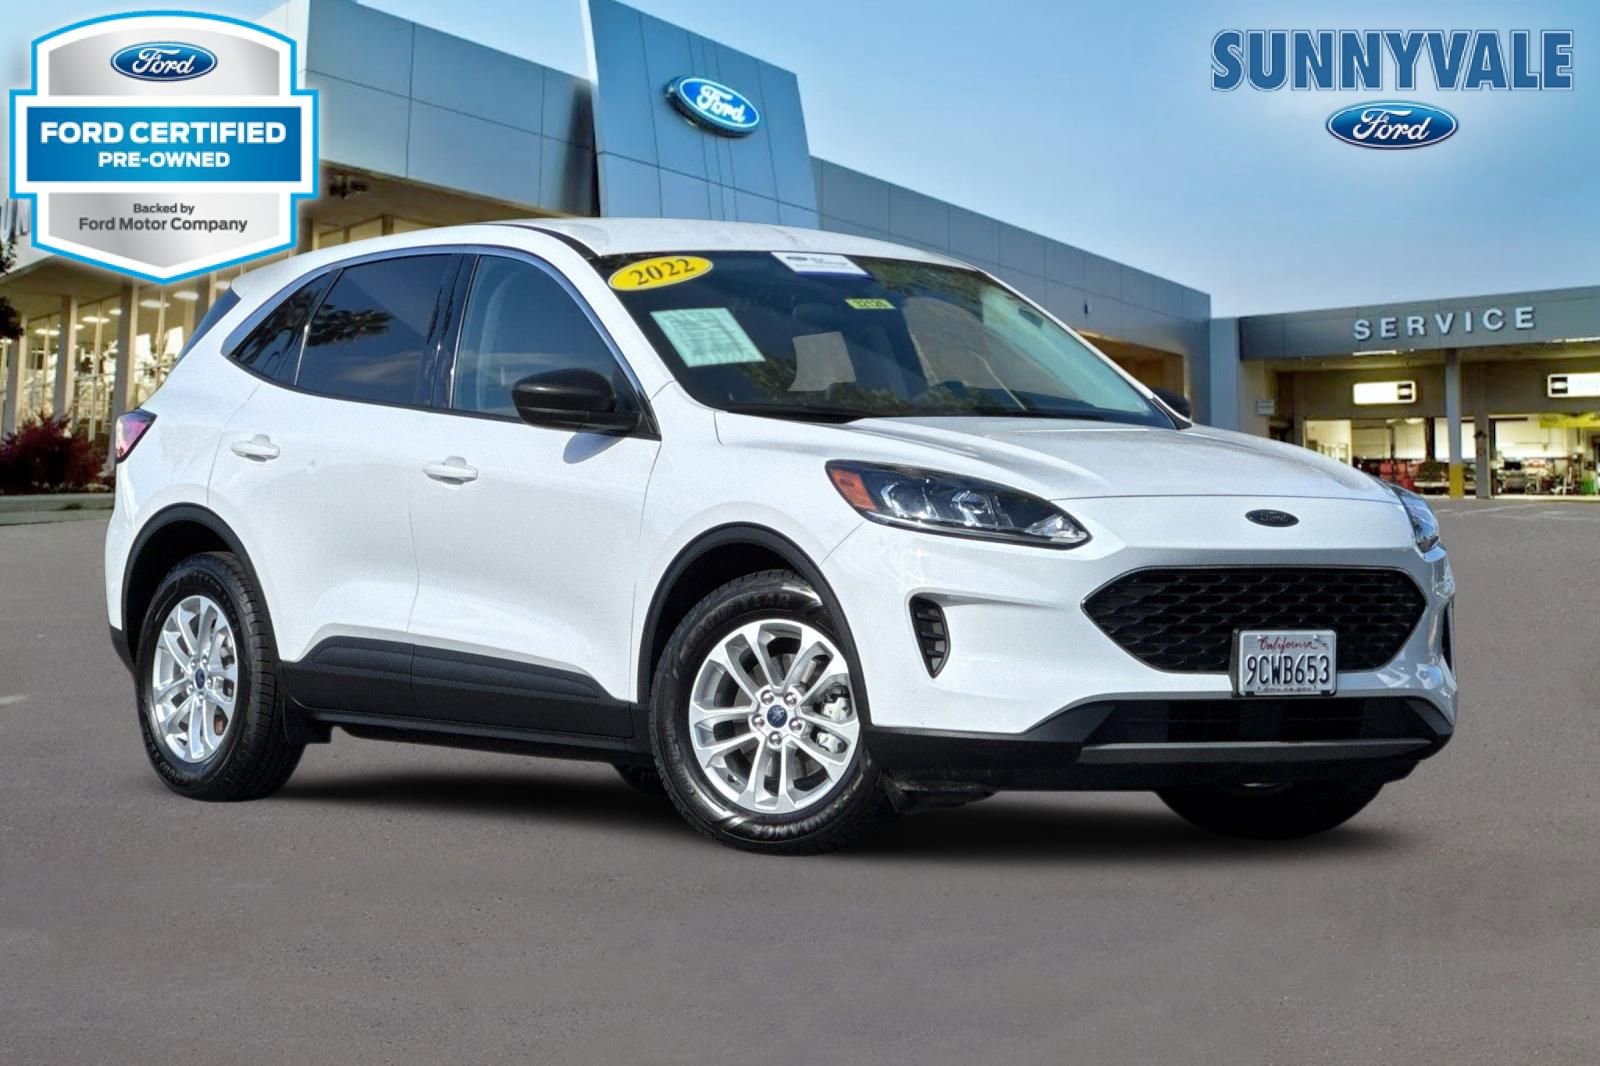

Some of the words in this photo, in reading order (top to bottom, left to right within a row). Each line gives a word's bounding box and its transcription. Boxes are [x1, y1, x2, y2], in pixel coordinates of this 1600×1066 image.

[696, 85, 746, 123] Ford
[629, 257, 696, 286] 2022
[1353, 306, 1536, 341] SERVICE
[1258, 635, 1318, 654] California
[1246, 654, 1330, 686] 9CWB653
